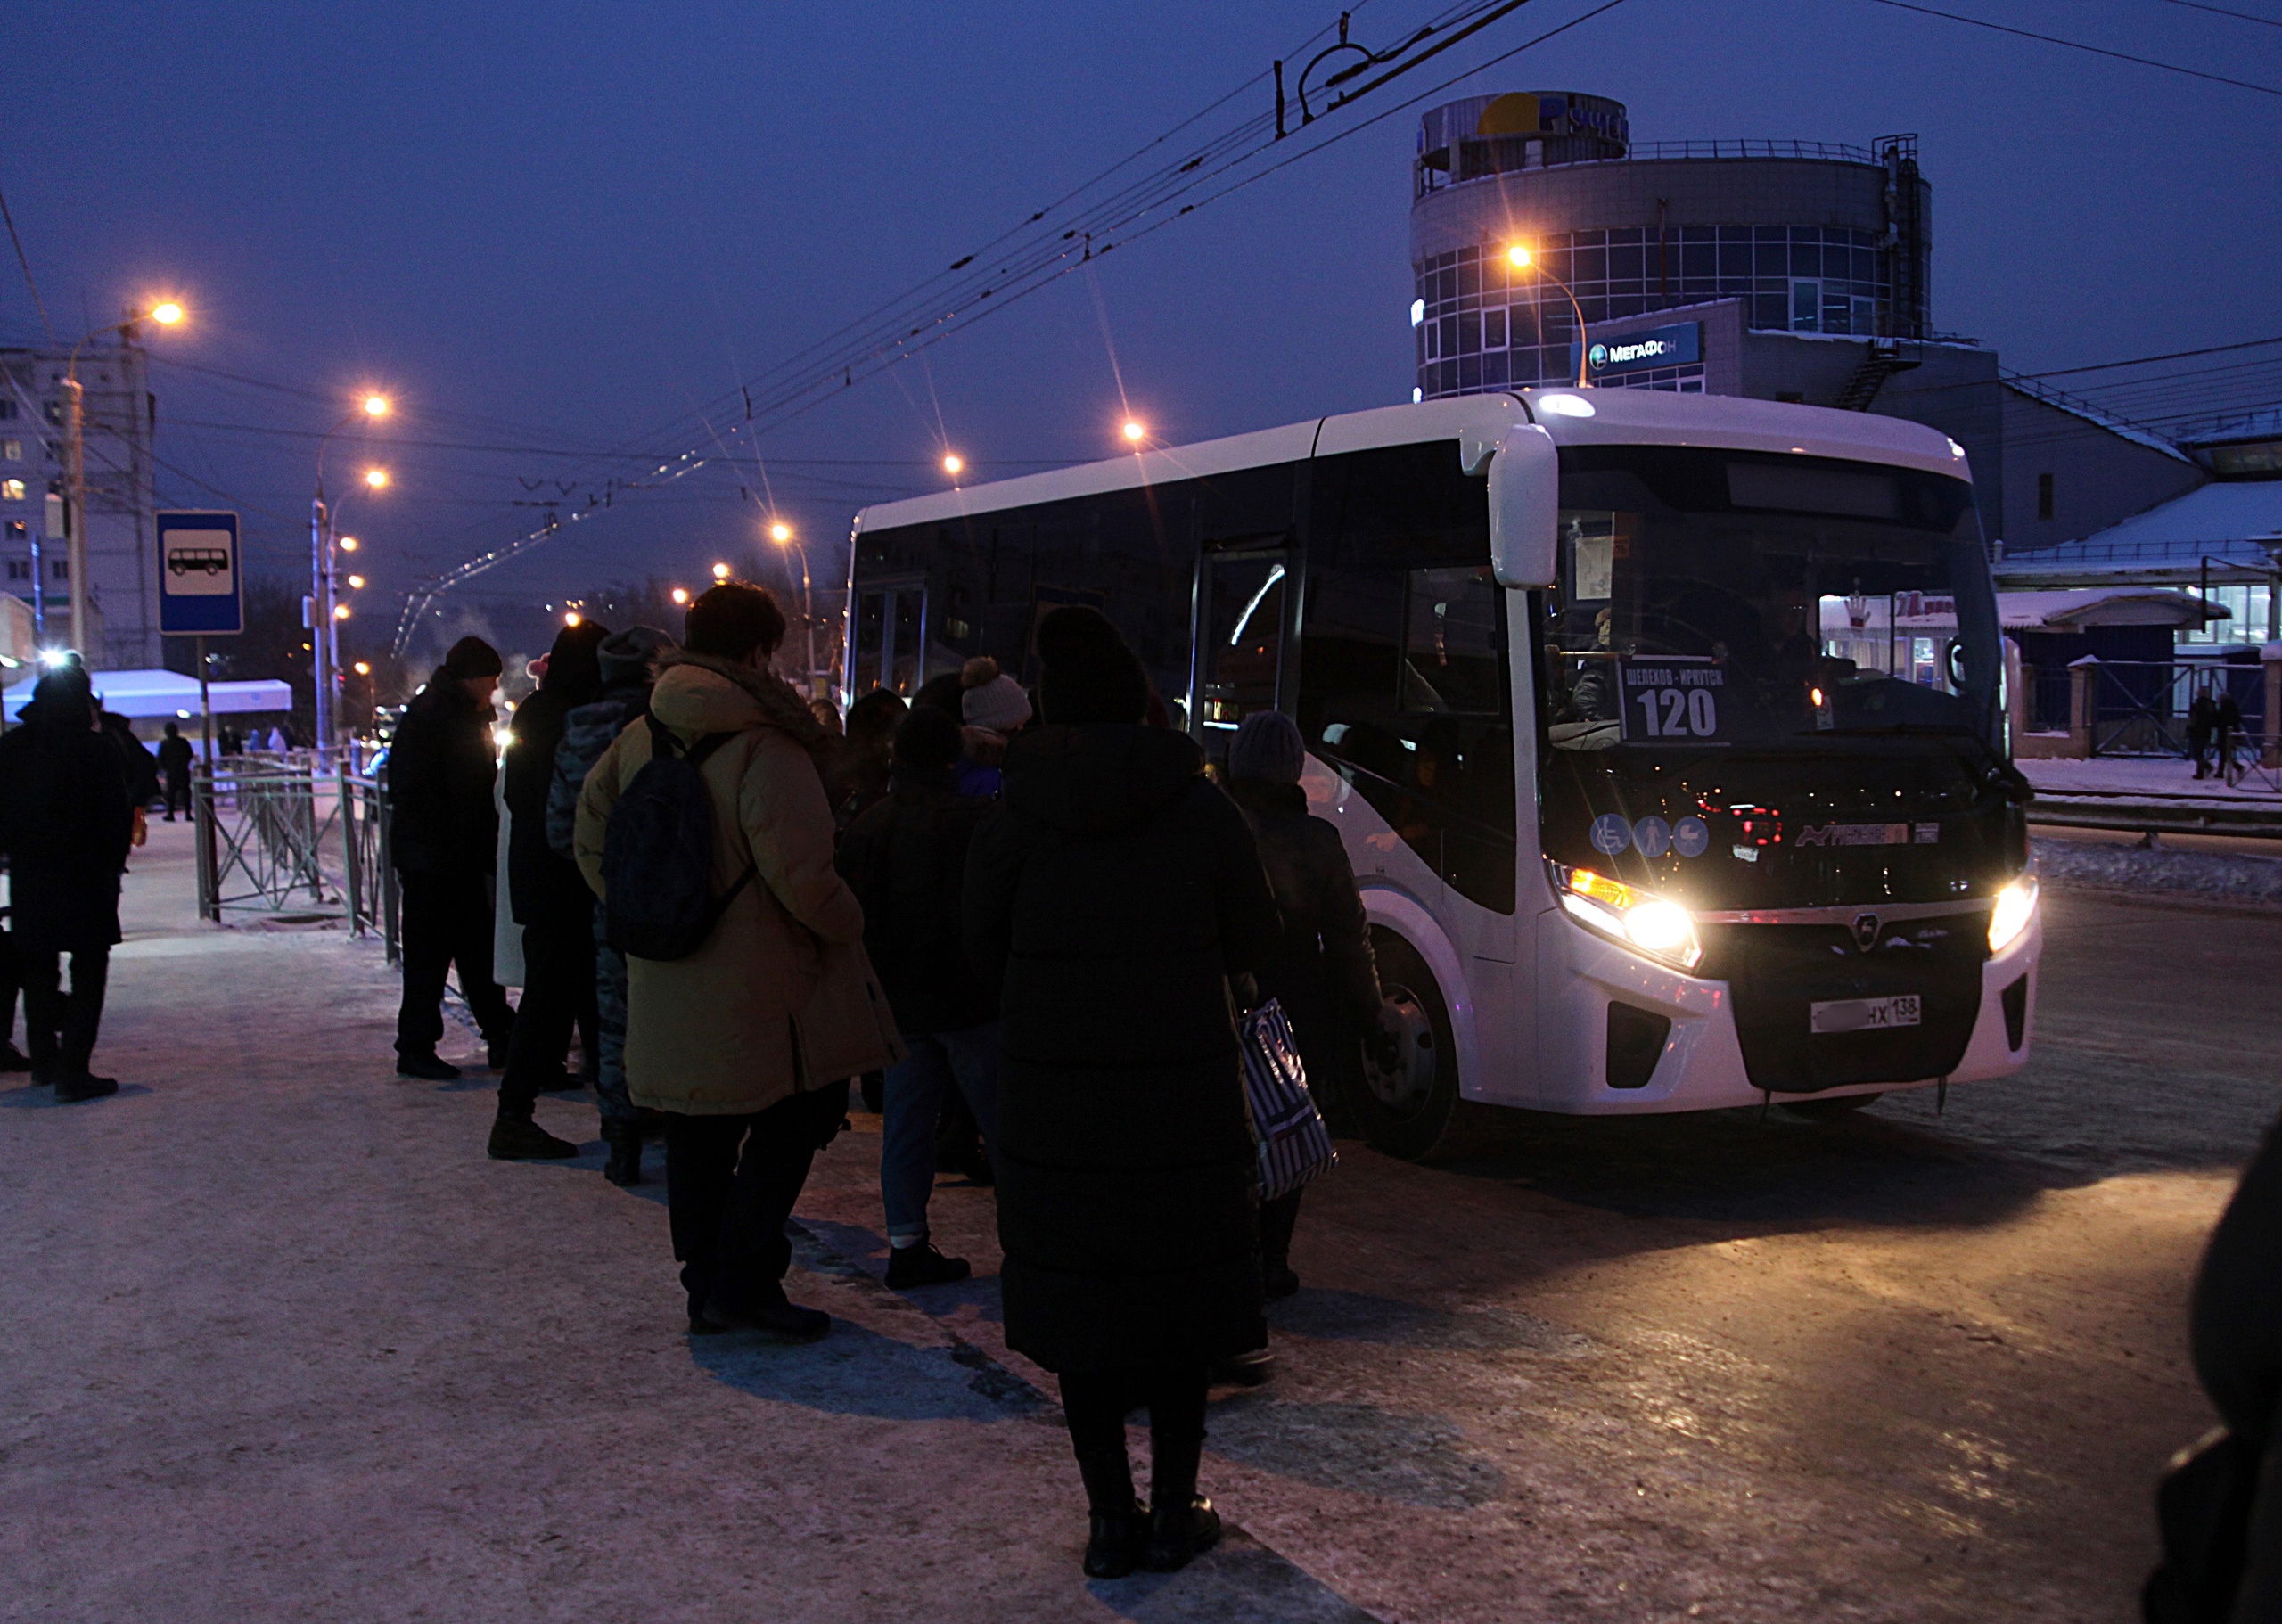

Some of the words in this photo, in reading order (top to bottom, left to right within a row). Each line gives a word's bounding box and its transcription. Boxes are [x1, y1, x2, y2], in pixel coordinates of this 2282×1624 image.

[1610, 340, 1677, 363] МЕГАФОН
[1626, 668, 1673, 685] ШЕЛЕХОВ
[1679, 668, 1724, 686] ИРКУТСК
[1636, 687, 1717, 737] 120
[1892, 997, 1917, 1015] 138
